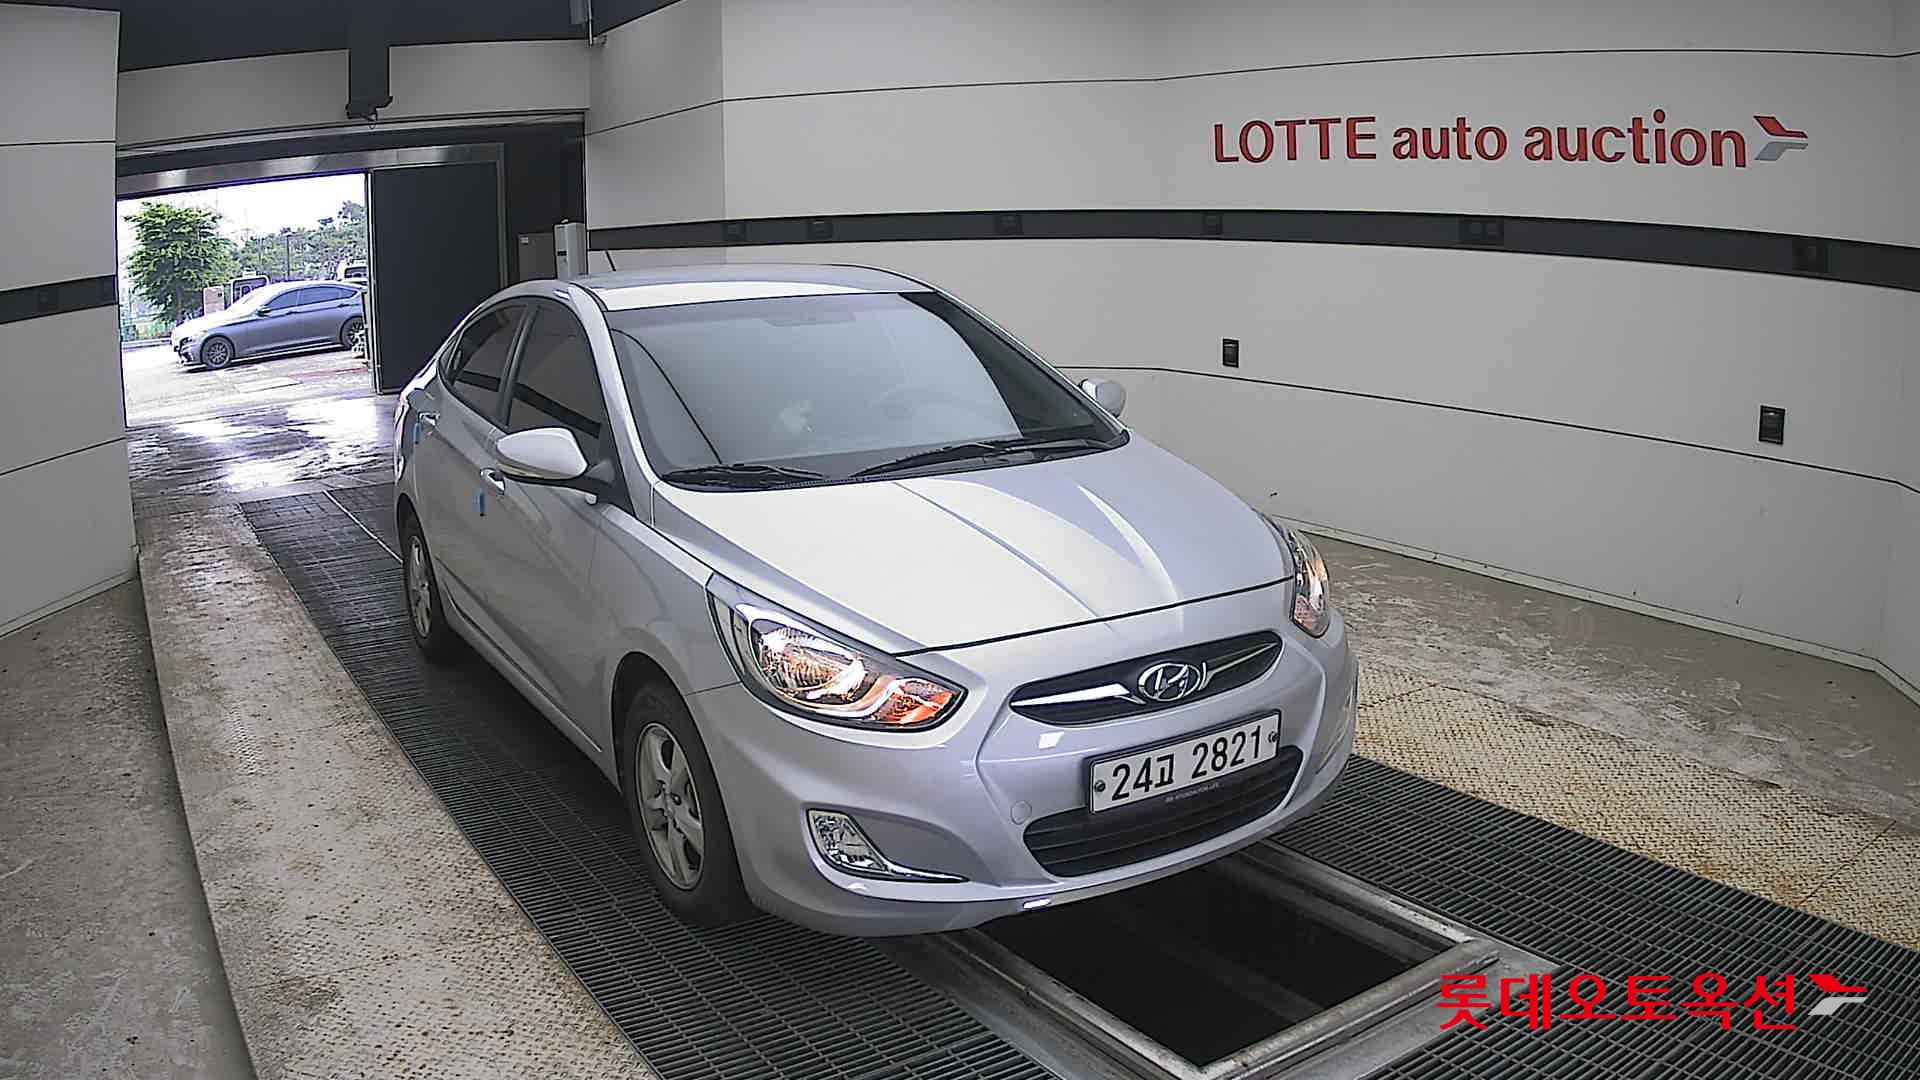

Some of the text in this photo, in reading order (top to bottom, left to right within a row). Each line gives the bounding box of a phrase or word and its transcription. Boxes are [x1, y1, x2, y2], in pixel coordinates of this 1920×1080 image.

[1213, 109, 1747, 169] LOTTE auto auction
[1111, 753, 1175, 801] 24고
[1191, 724, 1262, 780] 2821
